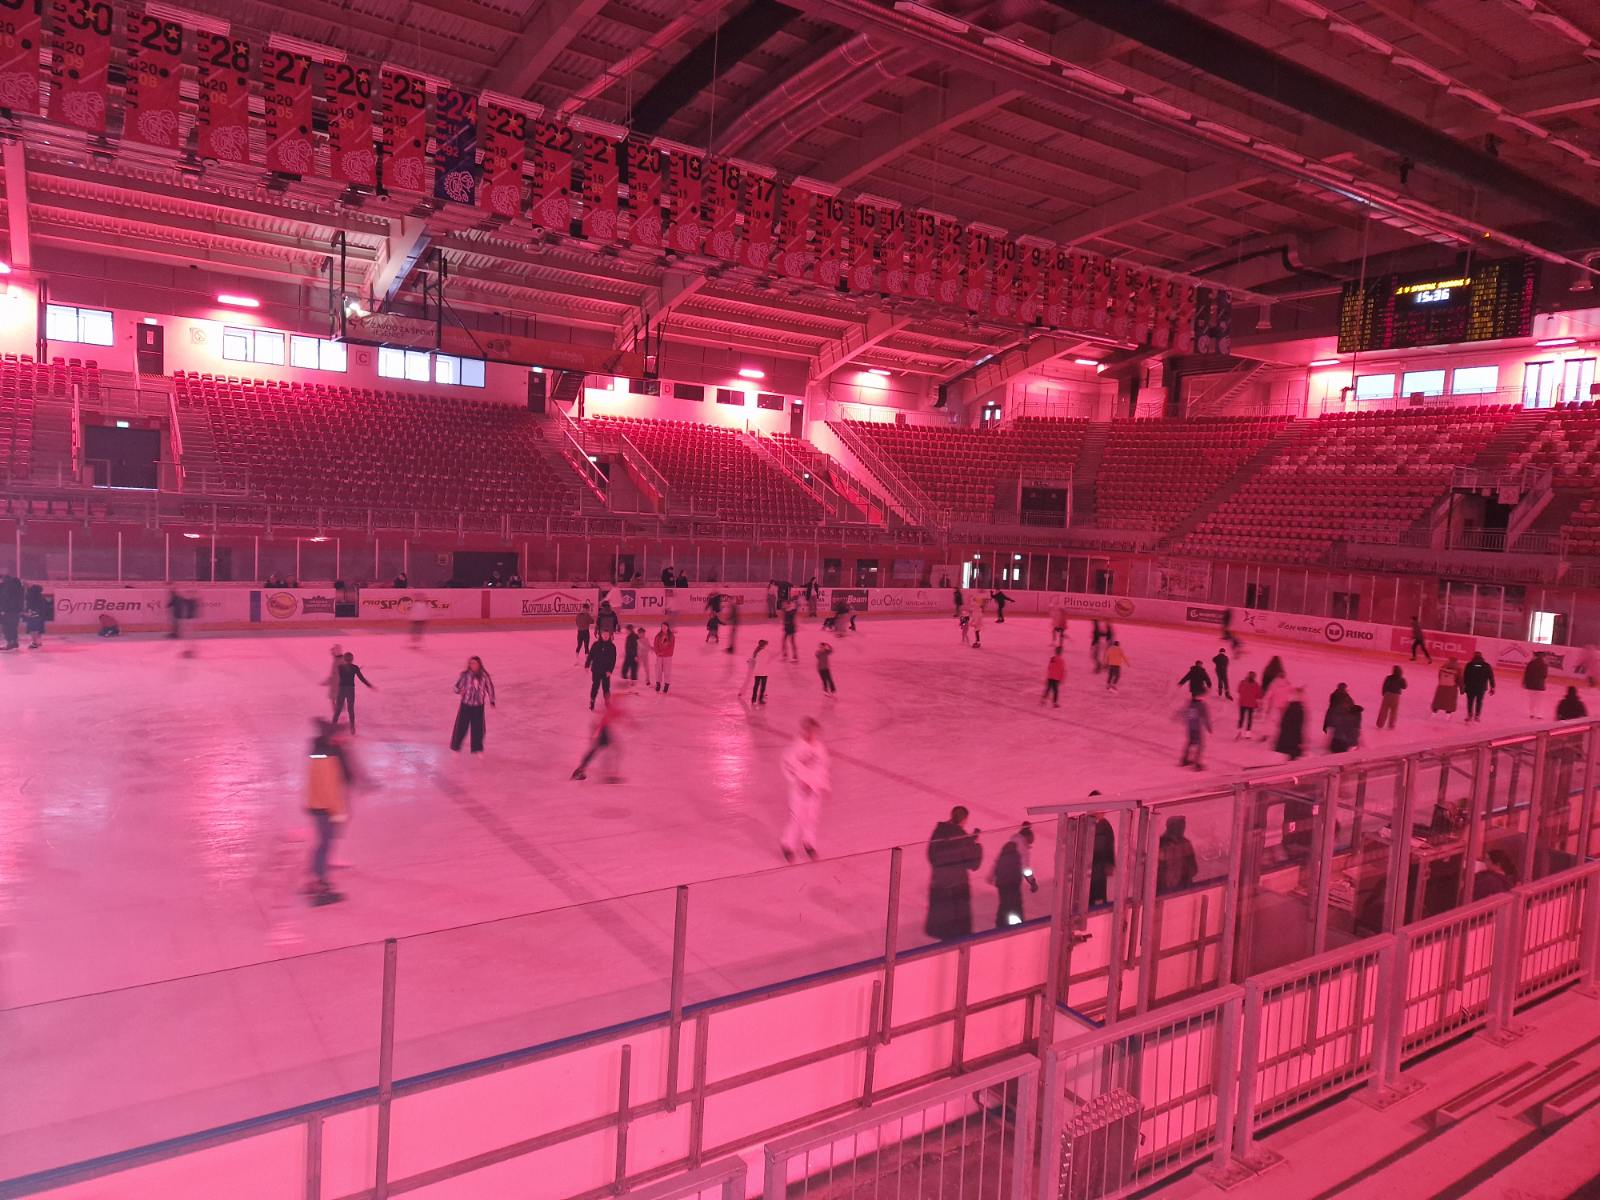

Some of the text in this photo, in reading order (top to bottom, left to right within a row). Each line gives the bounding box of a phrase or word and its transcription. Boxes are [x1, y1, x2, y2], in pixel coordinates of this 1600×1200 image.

[68, 0, 113, 36] 30
[51, 0, 66, 90] JESENIC
[140, 15, 183, 55] 29
[65, 41, 85, 56] 20
[126, 10, 140, 109] JESENICE
[210, 35, 250, 73] 28
[139, 61, 158, 75] 20
[197, 30, 210, 125] JESENICE
[276, 51, 312, 85] 27
[209, 79, 228, 92] 20
[262, 46, 277, 140] JESENICE
[336, 64, 371, 99] 26
[393, 74, 426, 109] 25
[276, 94, 293, 107] 20
[323, 59, 340, 152] JESENICE
[447, 90, 477, 124] 24
[340, 107, 354, 119] 19
[382, 71, 394, 157] JESENICE
[395, 115, 408, 127] 19
[496, 107, 527, 140] 23
[544, 123, 573, 154] 22
[495, 146, 507, 158] 19
[637, 145, 661, 174] 20
[543, 160, 556, 172] 19
[678, 154, 702, 180] 19
[718, 163, 740, 190] 18
[754, 177, 777, 202] 17
[824, 198, 844, 222] 16
[856, 204, 876, 228] 15
[887, 209, 905, 232] 14
[917, 214, 935, 237] 13
[944, 221, 962, 245] 12
[975, 233, 990, 256] 11
[1000, 239, 1016, 261] 10
[1031, 248, 1041, 267] 9
[1057, 252, 1065, 271] 8
[1080, 255, 1089, 274] 7
[1416, 288, 1450, 303] 15:36
[359, 353, 367, 363] C
[57, 598, 142, 613] GymBeam
[640, 596, 664, 608] TPJ
[1064, 597, 1111, 609] Plinovodi
[1346, 630, 1374, 640] RIKO
[1399, 635, 1467, 654] PTROL
